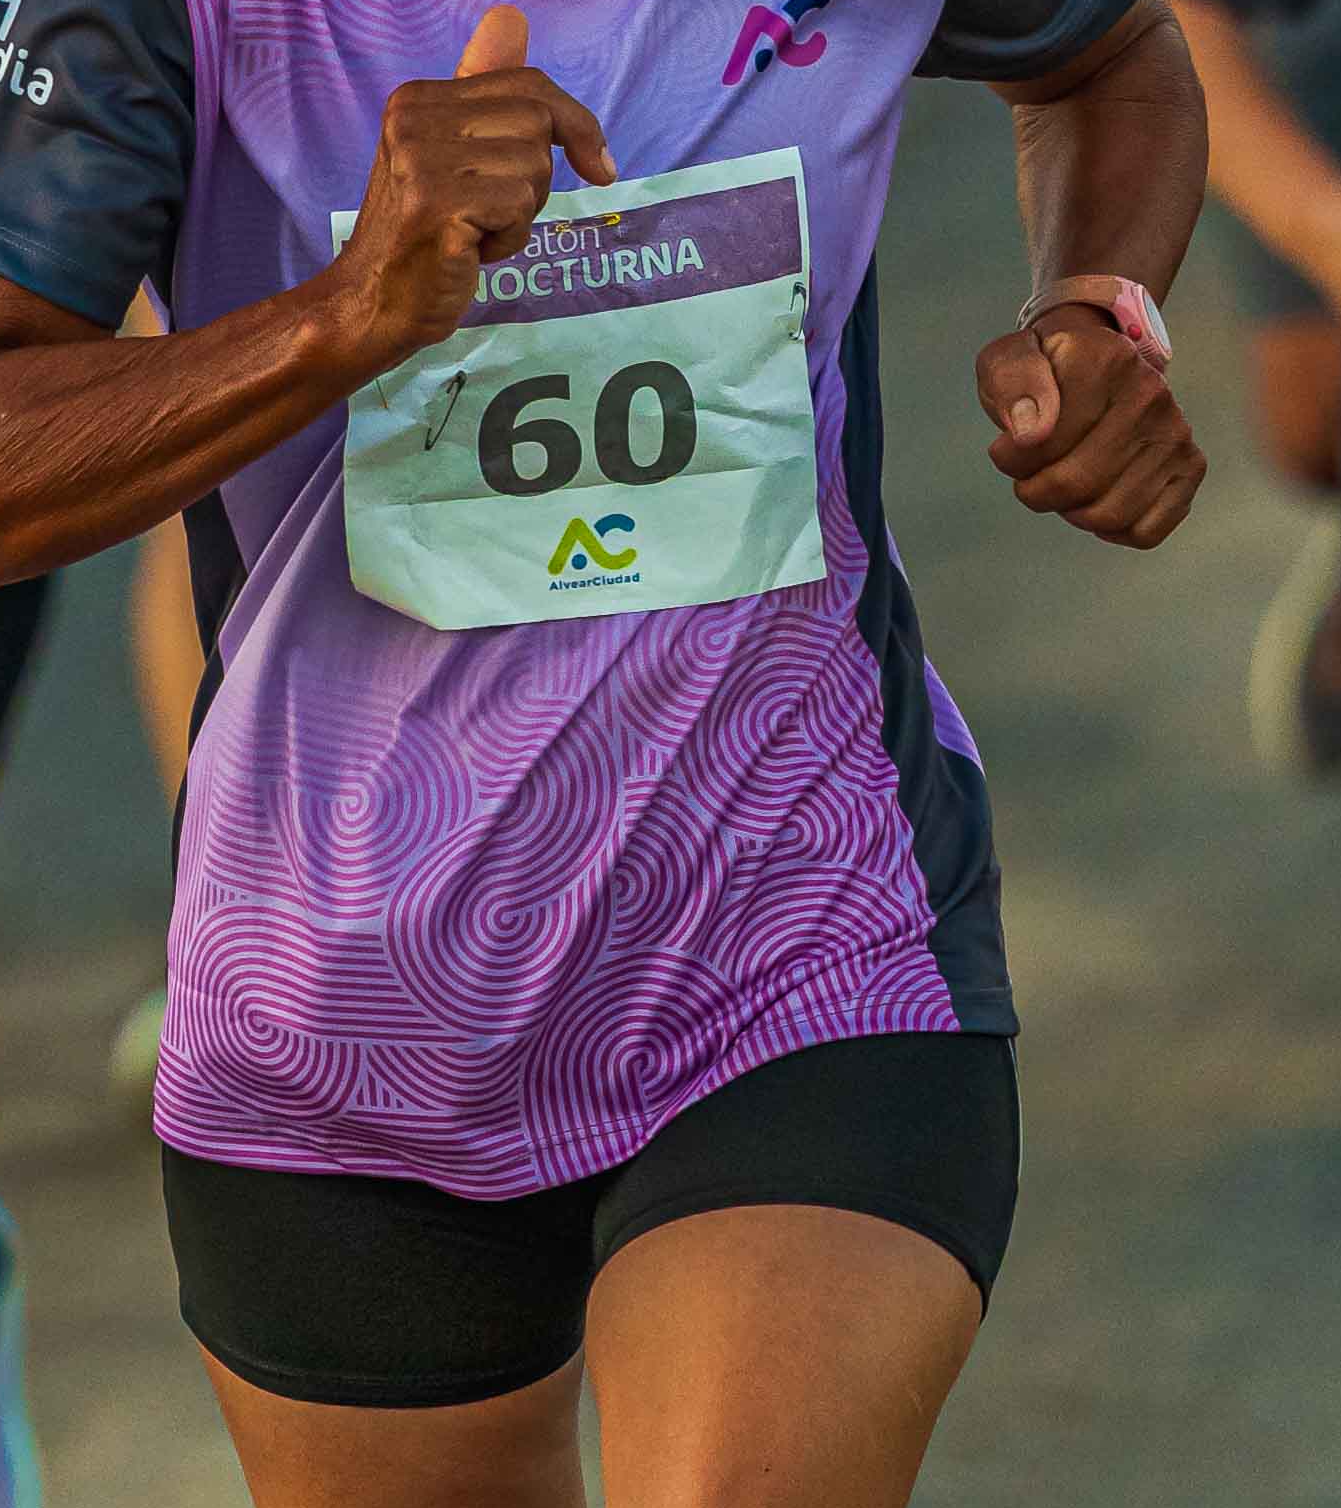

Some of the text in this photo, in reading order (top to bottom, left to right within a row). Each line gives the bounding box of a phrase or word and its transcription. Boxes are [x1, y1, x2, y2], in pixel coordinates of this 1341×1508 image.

[512, 221, 601, 259] atón
[477, 360, 698, 497] 60
[549, 572, 641, 591] AlvearCiudad
